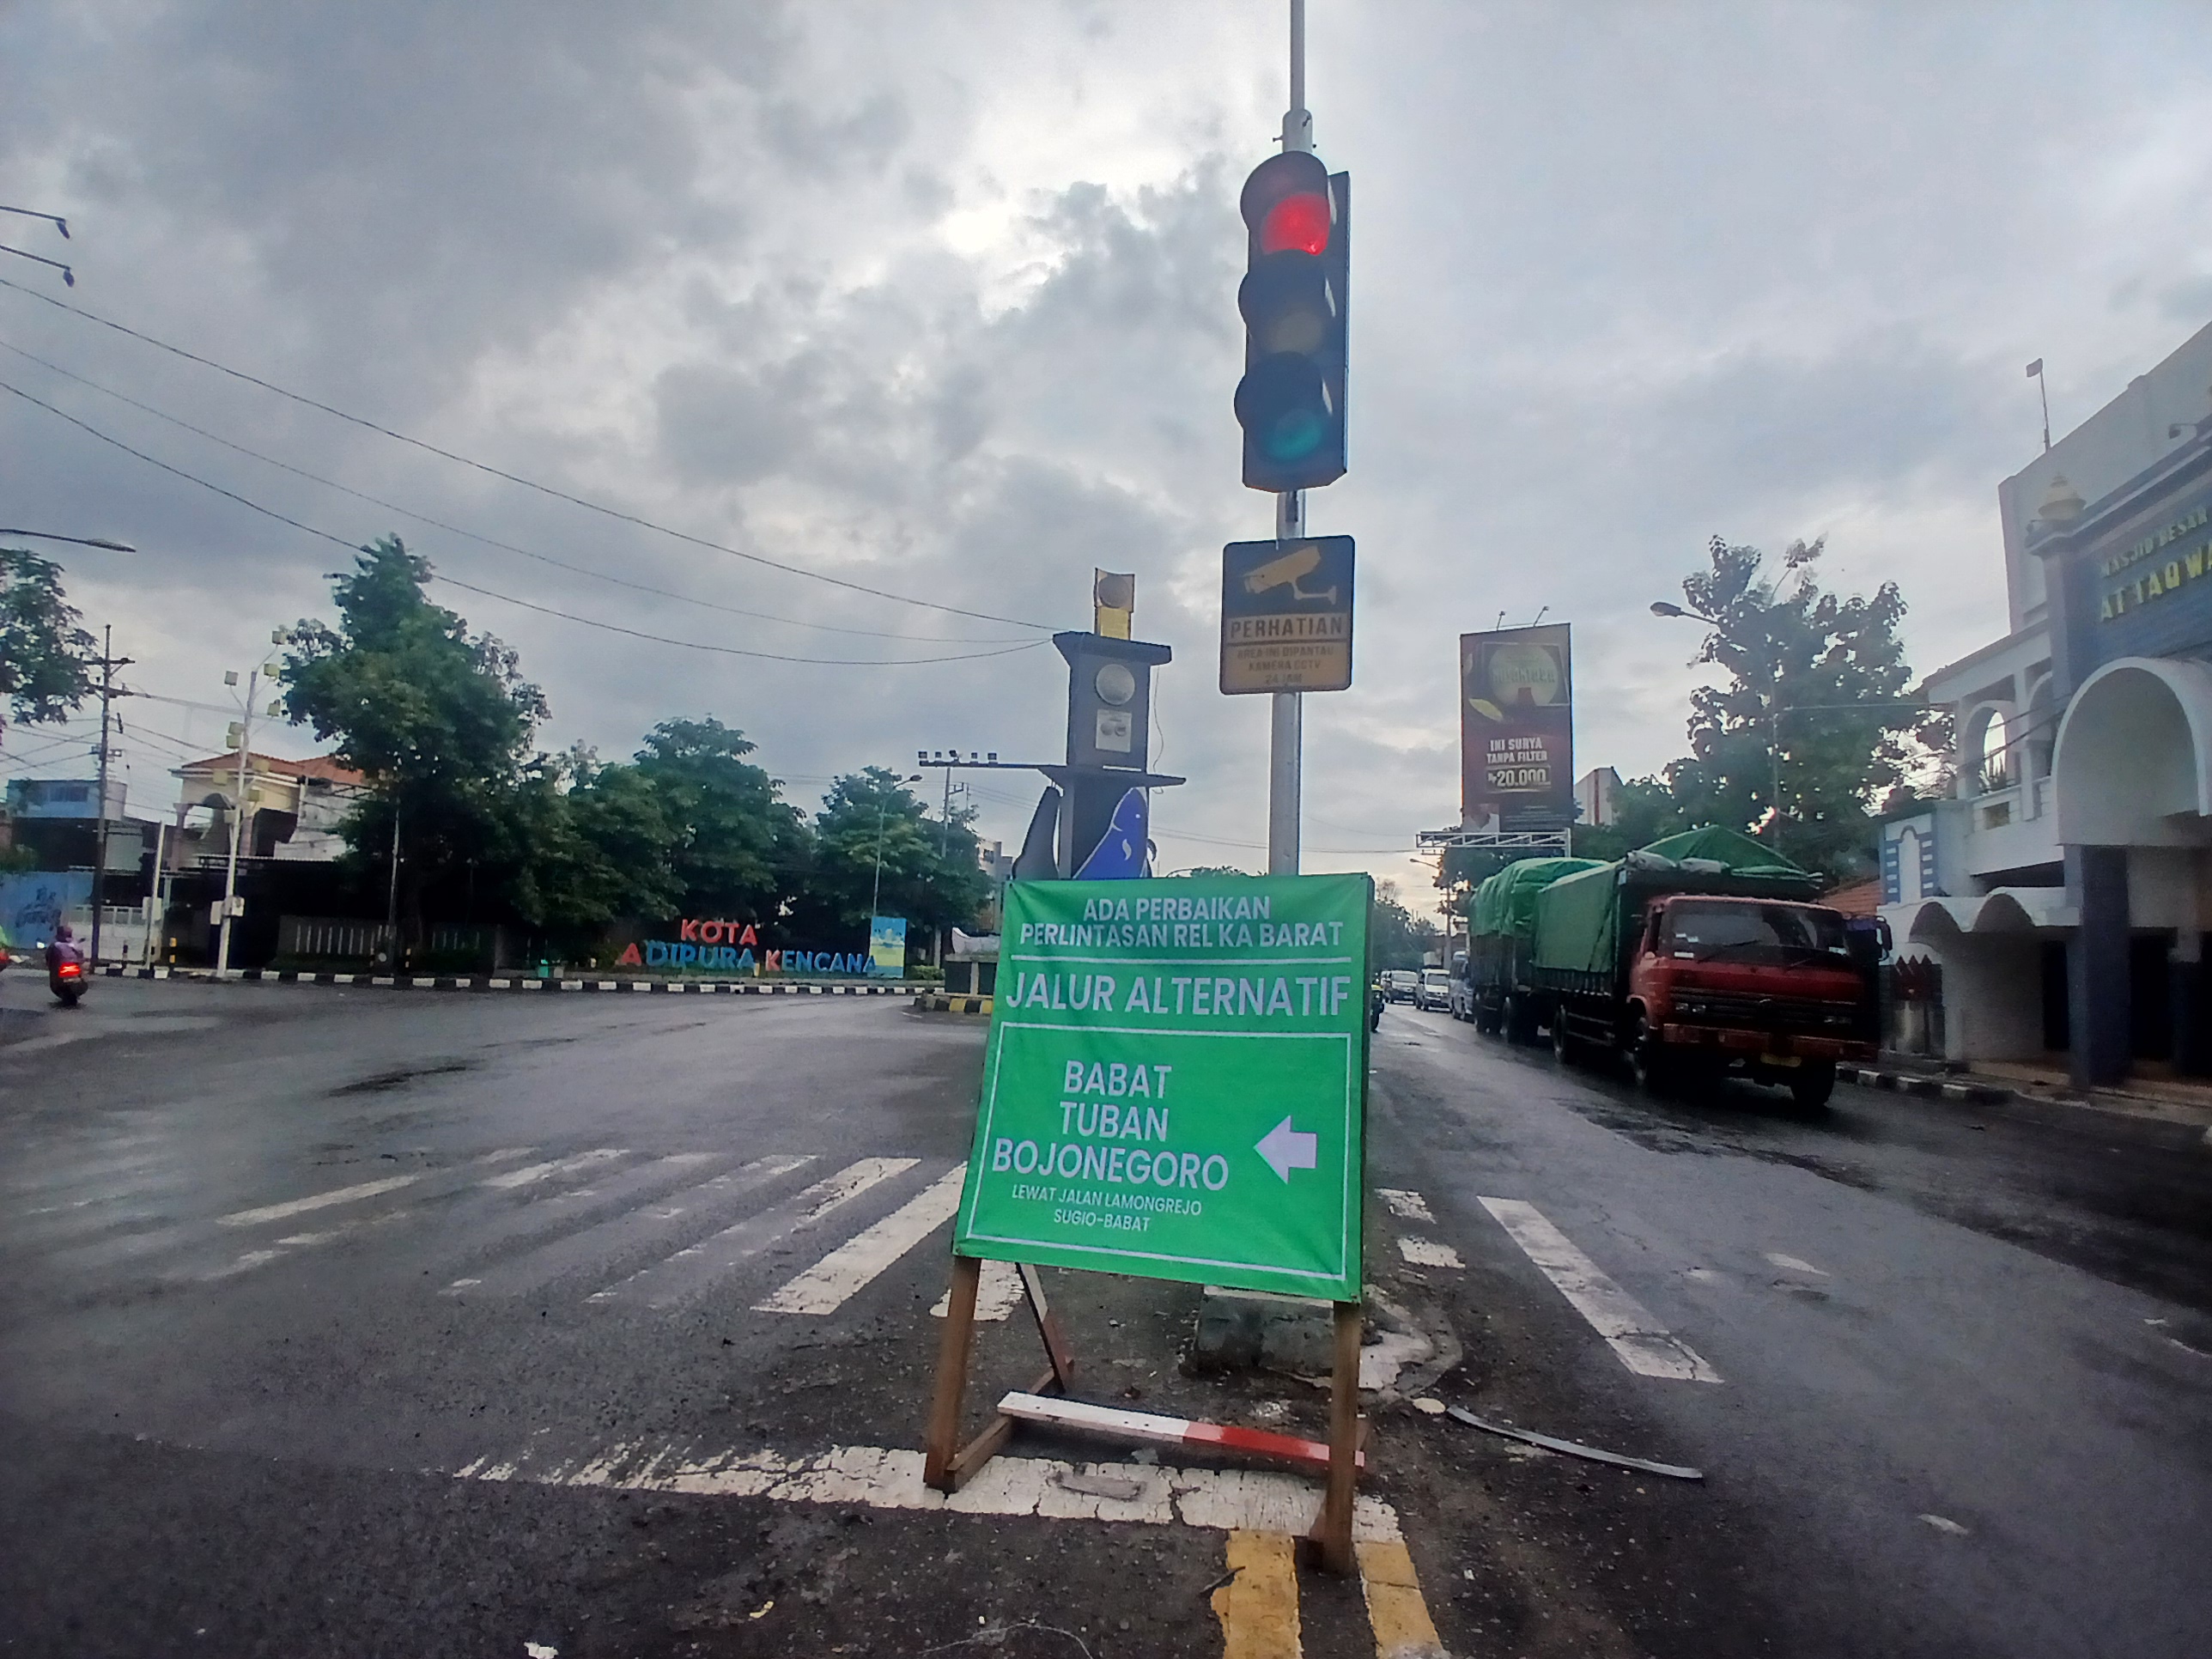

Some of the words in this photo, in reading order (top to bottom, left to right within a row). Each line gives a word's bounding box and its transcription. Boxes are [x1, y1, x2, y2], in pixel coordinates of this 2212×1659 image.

[1230, 617, 1342, 639] PERHATIAN
[1283, 646, 1334, 657] DIPANTAU
[1249, 660, 1291, 672] KAMERA
[1294, 659, 1322, 670] CCTV
[1486, 751, 1516, 764] TANPA
[1517, 750, 1548, 763] FILTER
[1490, 738, 1505, 752] INI
[1508, 737, 1543, 751] SURYA
[1084, 897, 1130, 921] ADA
[1135, 896, 1270, 921] PERBAIKAN
[680, 918, 758, 946] KOTA
[1020, 923, 1167, 947] PERLINTASAN
[1175, 924, 1212, 947] REL
[1219, 923, 1253, 947] KA
[1260, 921, 1344, 947] BARAT
[620, 940, 756, 970] ADIPURA
[765, 949, 878, 974] KENCANA
[1006, 972, 1115, 1012] JALUR
[1126, 975, 1352, 1017] ALTERNATIF
[1064, 1060, 1172, 1099] BABAT
[1060, 1102, 1169, 1142] TUBAN
[993, 1138, 1229, 1191] BOJONEGORO
[1012, 1184, 1056, 1201] LEWAT
[1059, 1188, 1103, 1206] JALAN
[1105, 1192, 1202, 1216] LAMONGREJO
[1054, 1210, 1151, 1231] SUGIO-BABAT
